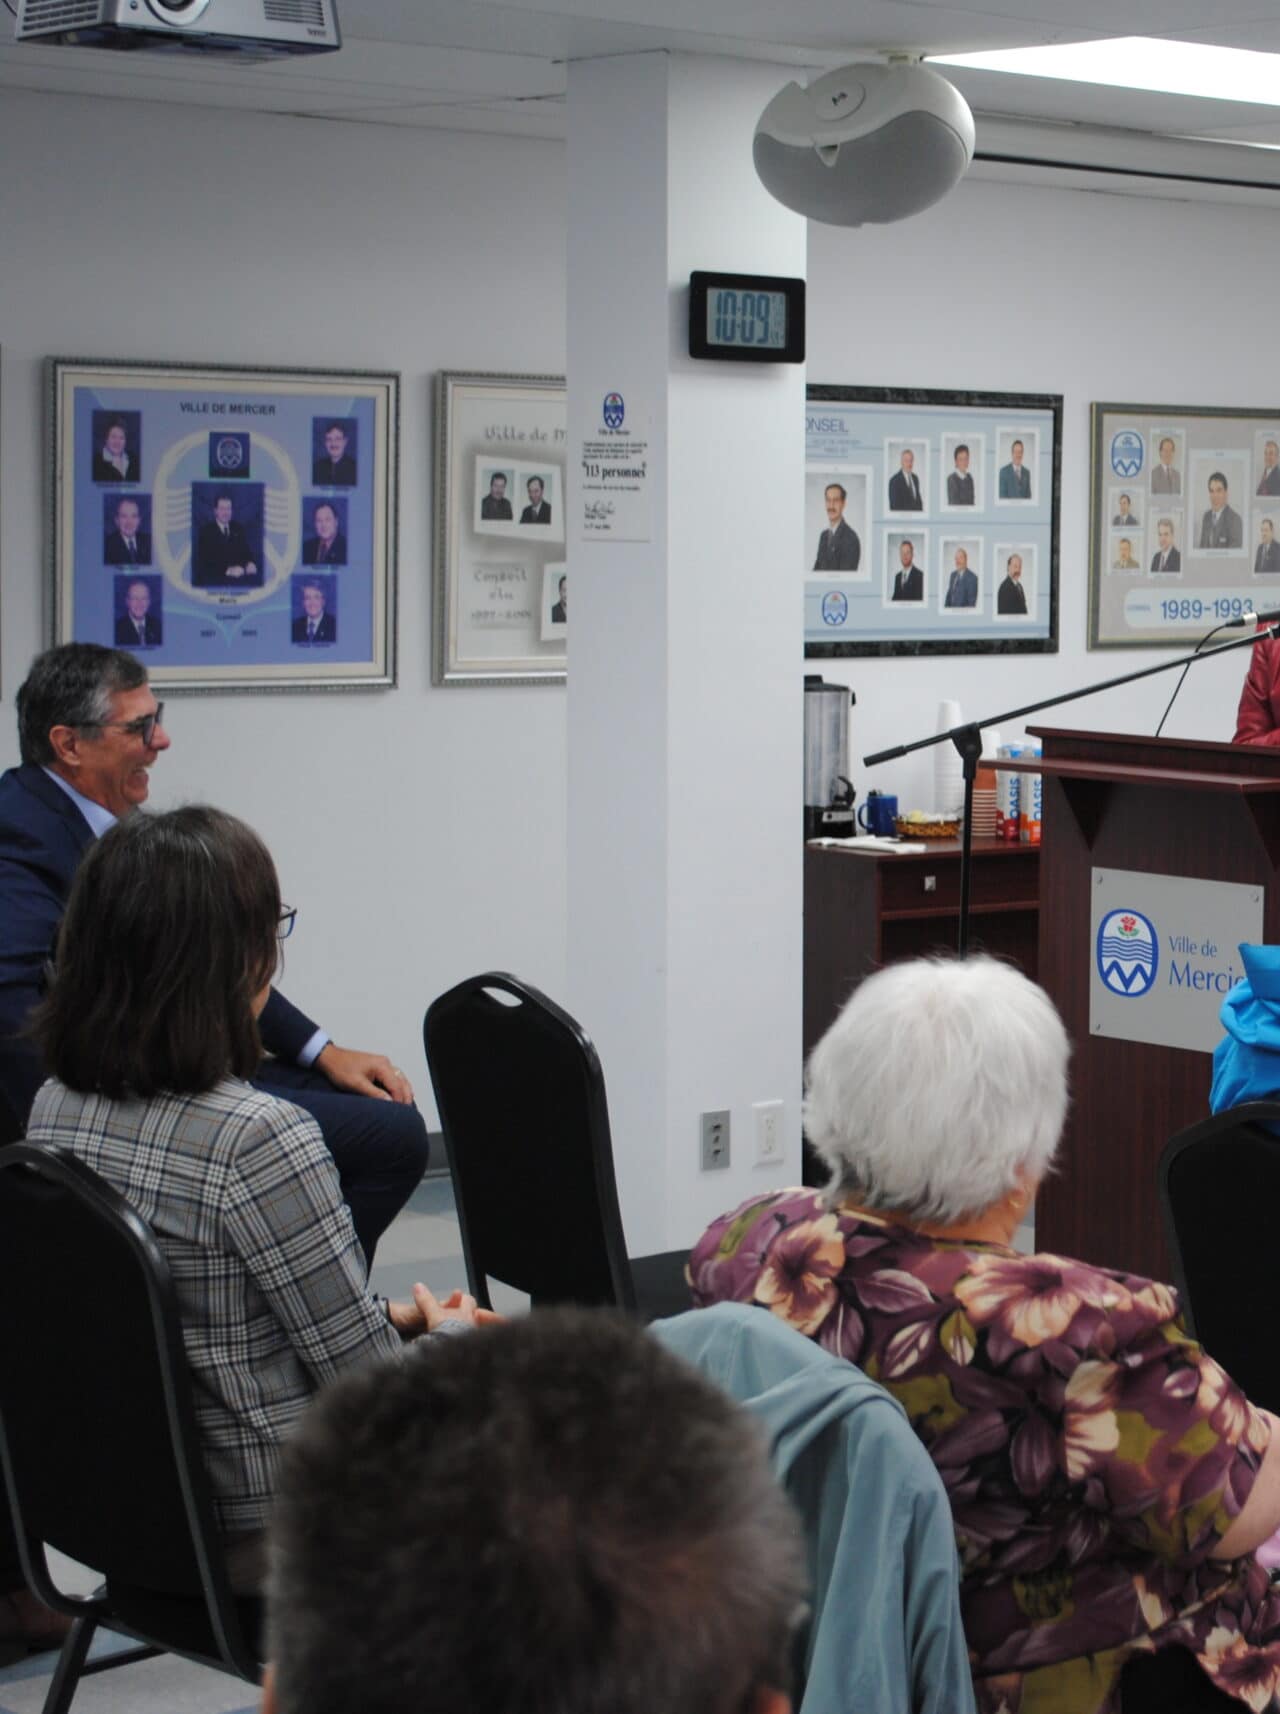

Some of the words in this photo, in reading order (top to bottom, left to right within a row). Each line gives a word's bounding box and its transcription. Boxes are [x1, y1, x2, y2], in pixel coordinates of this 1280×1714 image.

[716, 292, 771, 344] 10:09
[180, 402, 209, 414] VILLE
[211, 403, 225, 415] DE
[229, 403, 276, 416] MERCIER
[1161, 598, 1254, 620] 1989-1993
[1009, 777, 1020, 819] OASIS
[1168, 935, 1197, 955] Ville
[1201, 938, 1217, 958] de
